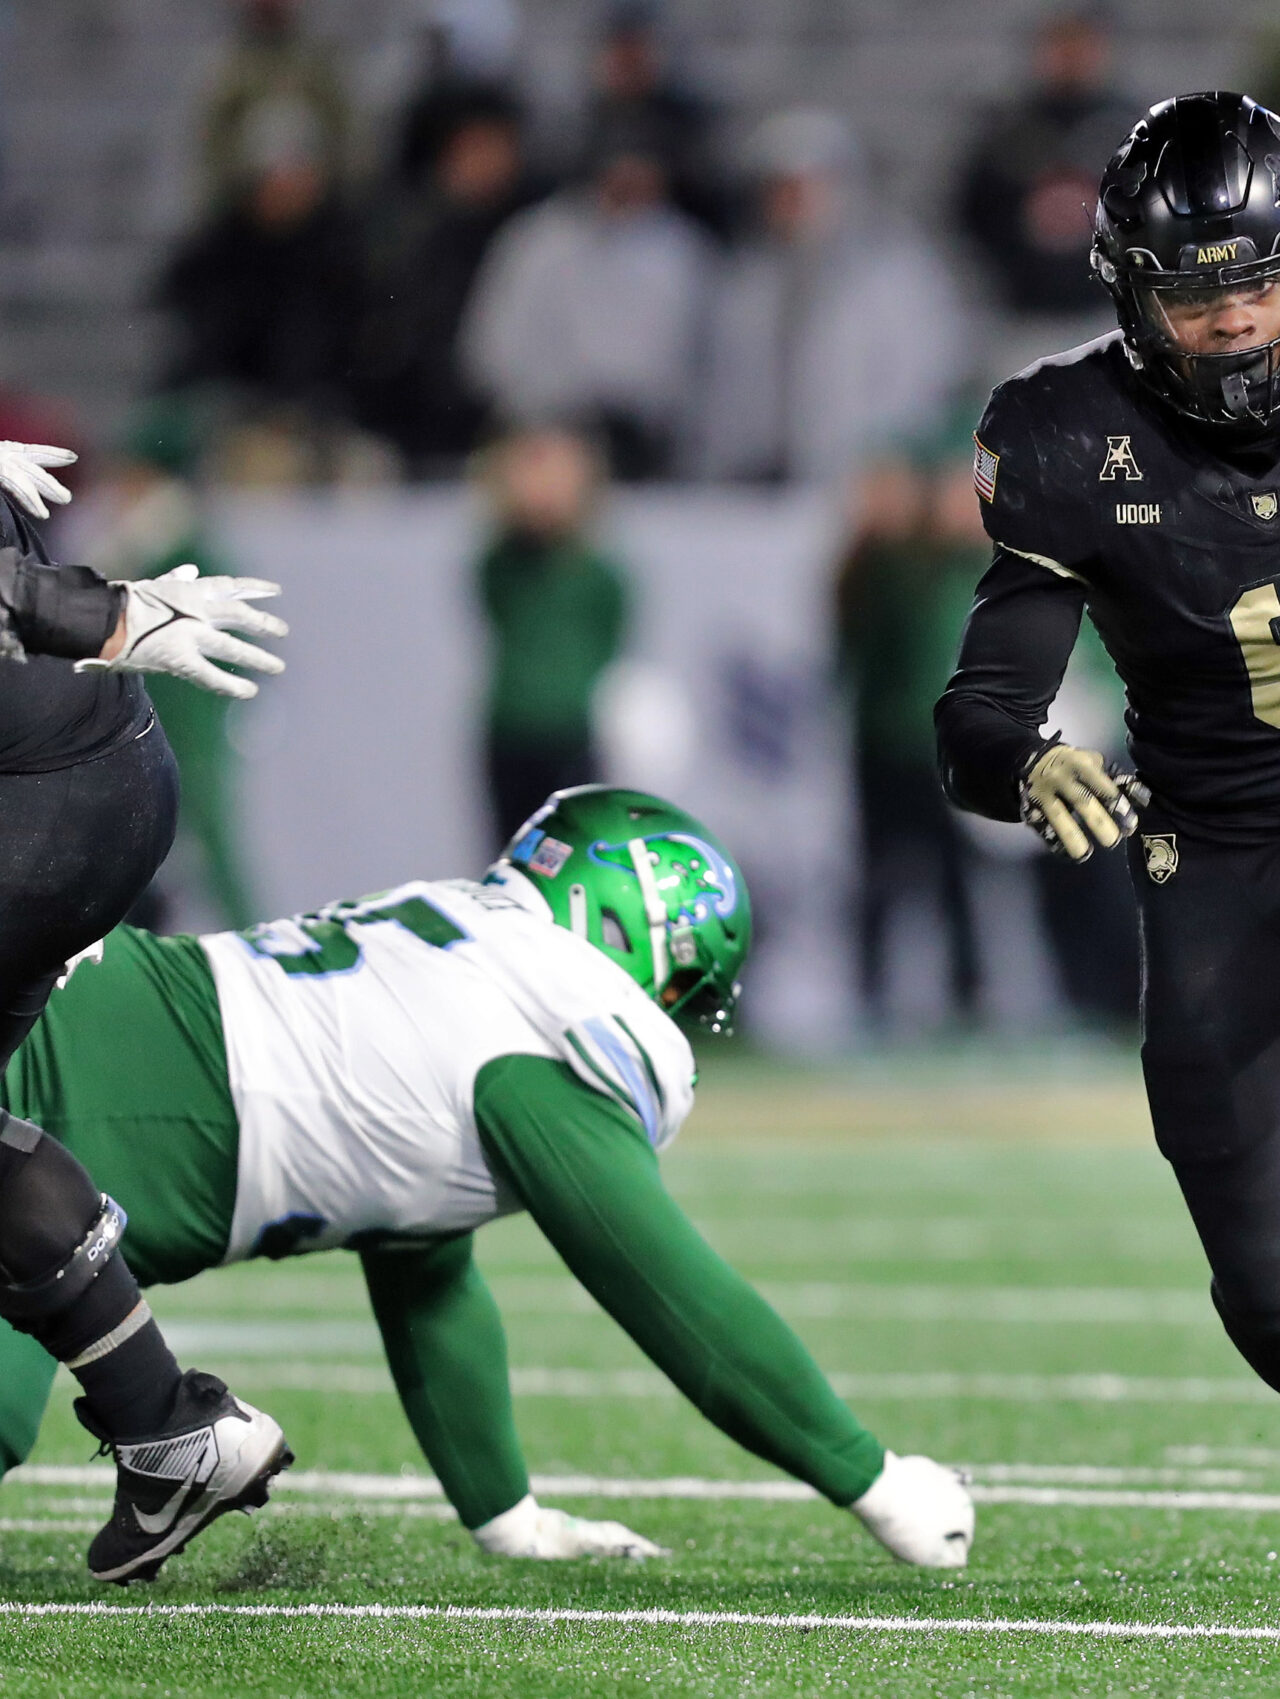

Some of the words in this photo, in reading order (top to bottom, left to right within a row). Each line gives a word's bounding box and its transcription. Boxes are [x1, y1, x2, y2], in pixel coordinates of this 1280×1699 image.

[1197, 243, 1237, 264] ARMY
[1100, 436, 1143, 480] A
[1116, 504, 1161, 524] UDOH
